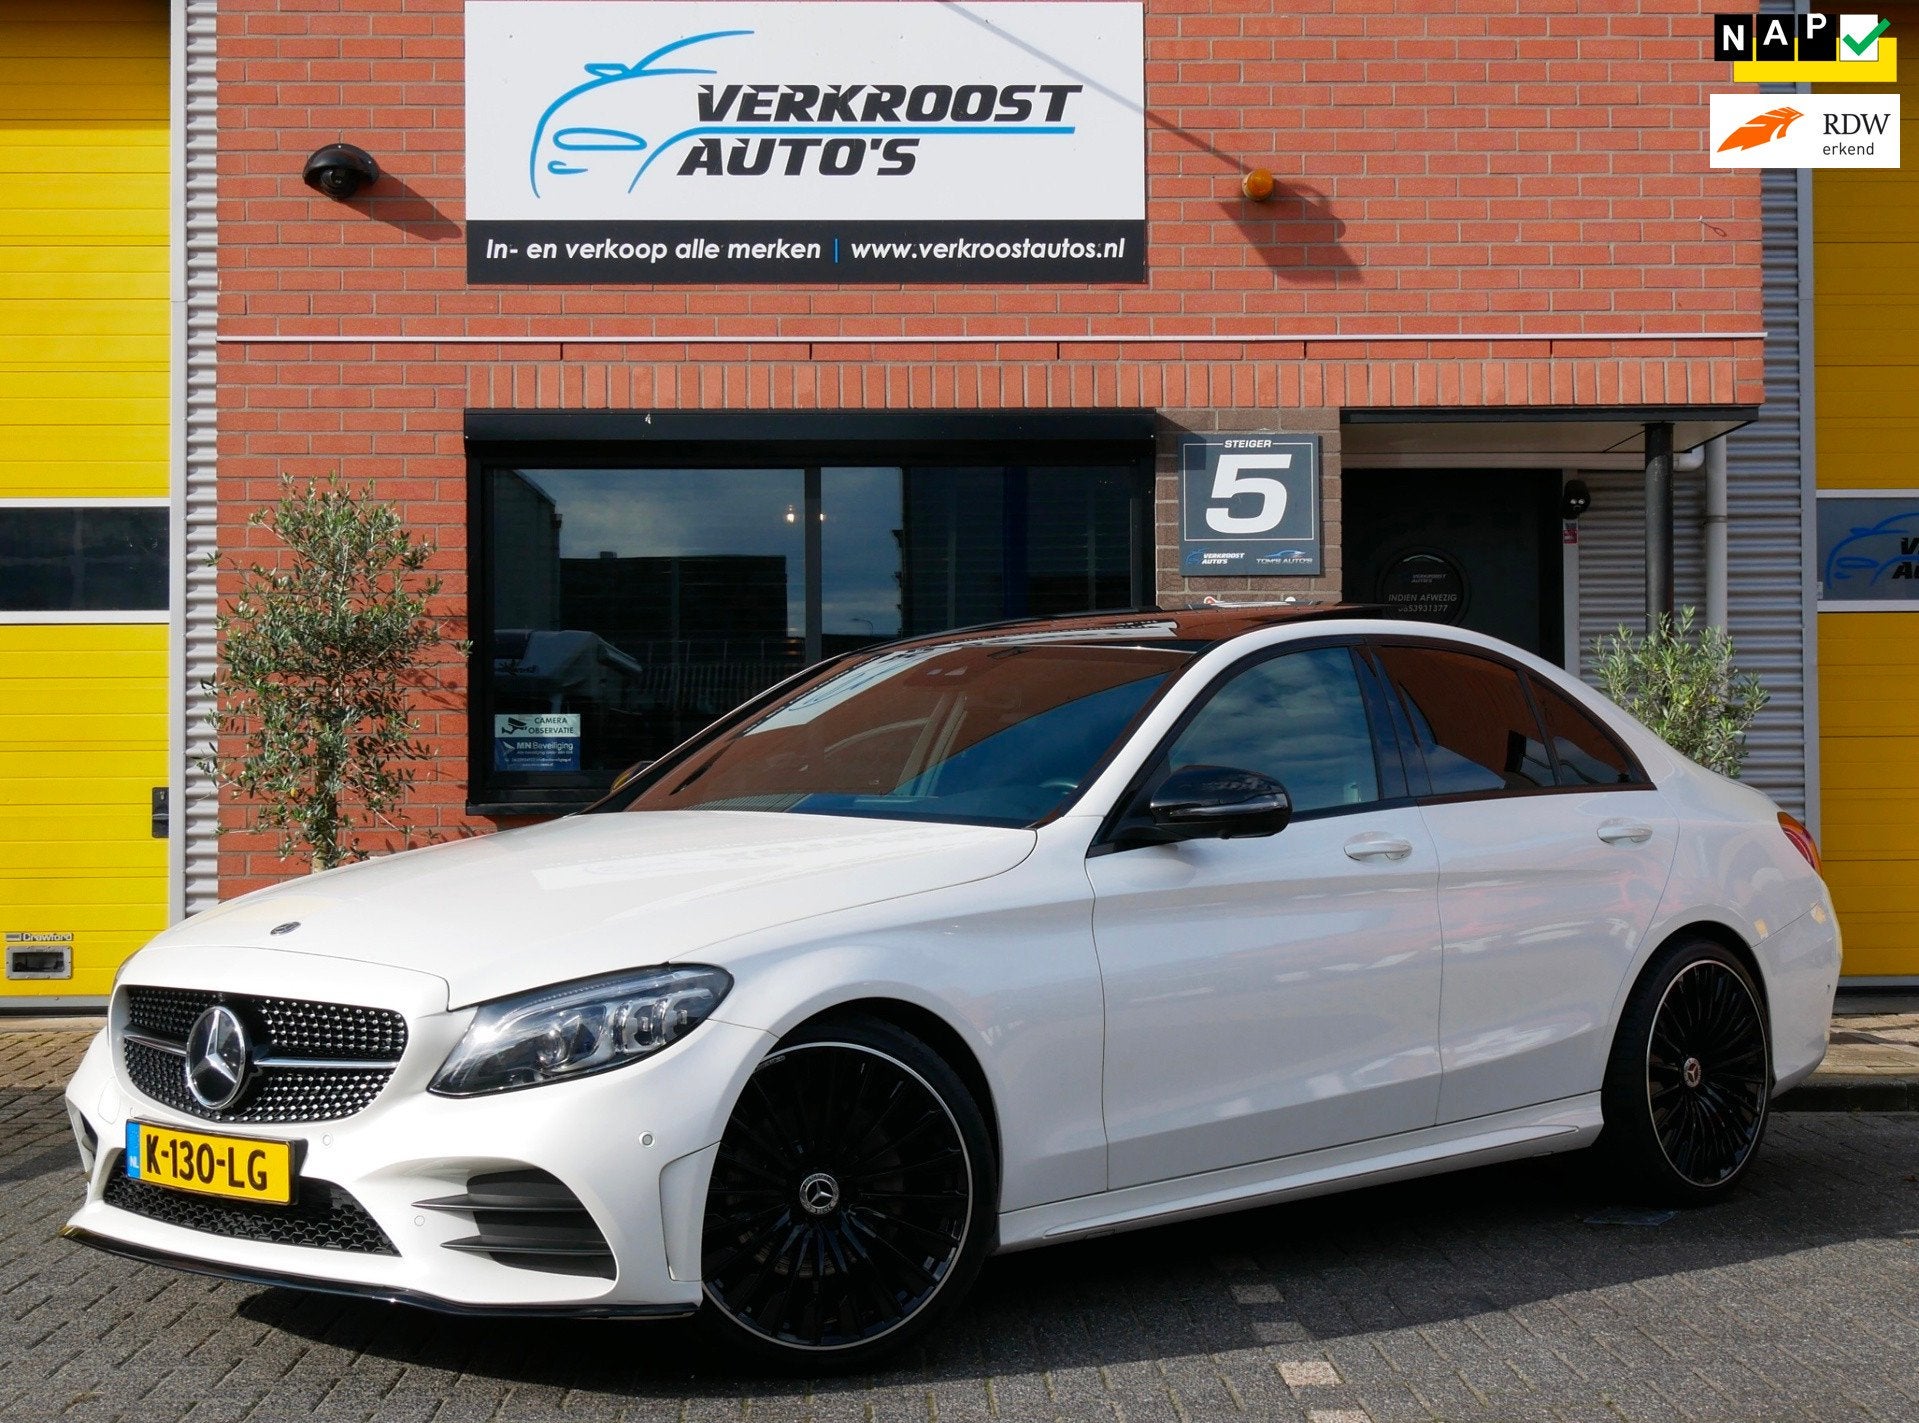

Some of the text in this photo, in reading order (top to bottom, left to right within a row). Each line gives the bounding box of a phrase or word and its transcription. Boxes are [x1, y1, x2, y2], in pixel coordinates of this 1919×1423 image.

[698, 84, 1084, 122] VERKROOST
[676, 138, 920, 176] AUTO'S
[486, 239, 822, 264] In- en verkoop alle merken
[851, 238, 1126, 259] www.verkroostautos.nl
[1224, 439, 1273, 449] STEIGER
[1205, 453, 1293, 534] 5
[1388, 594, 1458, 602] INDIEN AFWEZIG
[528, 726, 574, 735] OBSERVATIE
[129, 1155, 140, 1169] NL
[145, 1133, 268, 1192] K-130-LG
